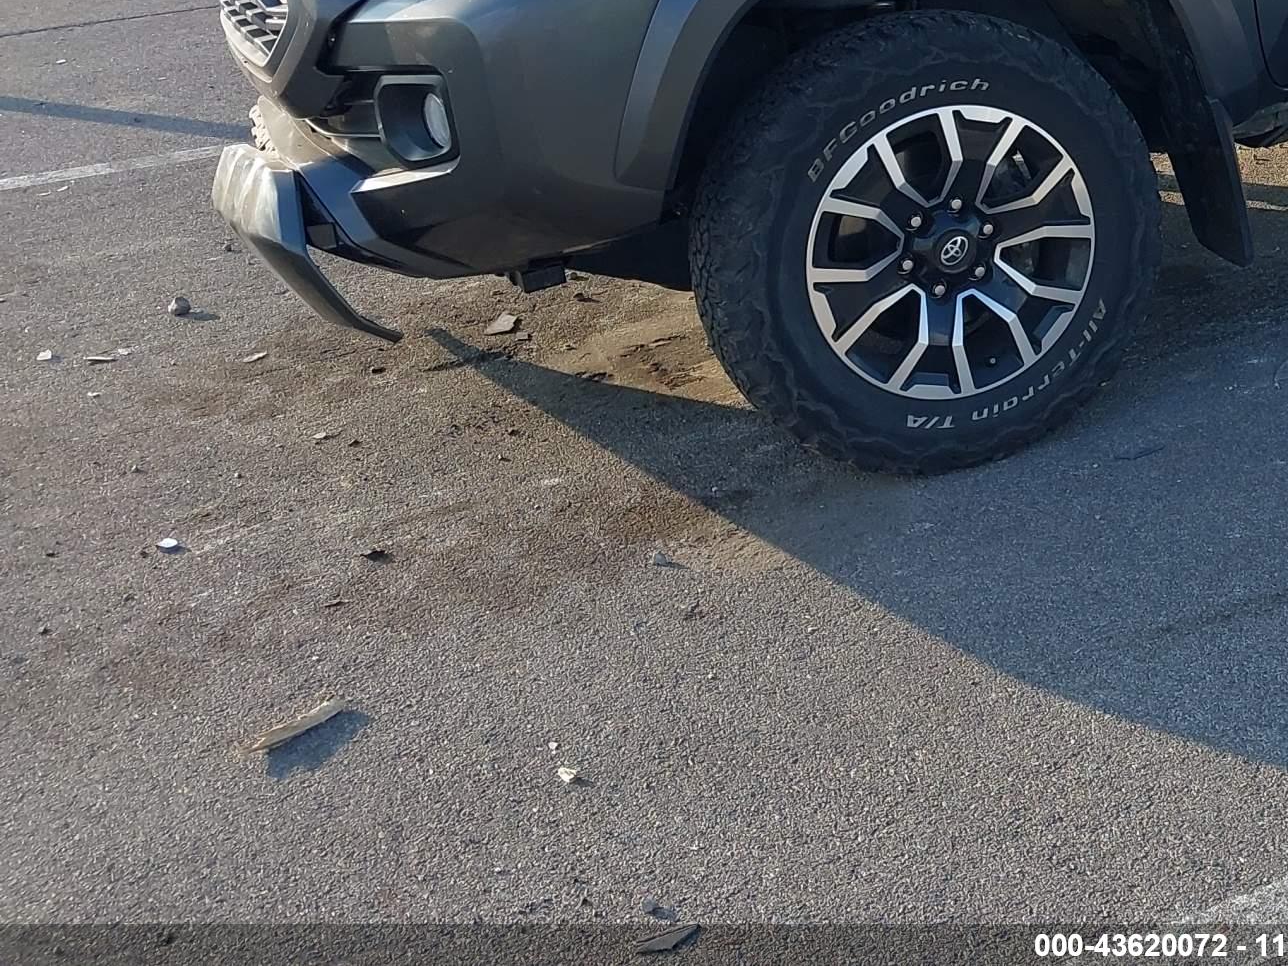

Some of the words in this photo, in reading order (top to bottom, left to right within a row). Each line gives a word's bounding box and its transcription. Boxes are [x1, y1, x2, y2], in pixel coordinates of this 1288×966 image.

[807, 77, 990, 183] BFGoodrich
[972, 297, 1107, 422] All-Terrain
[906, 413, 956, 431] T/A
